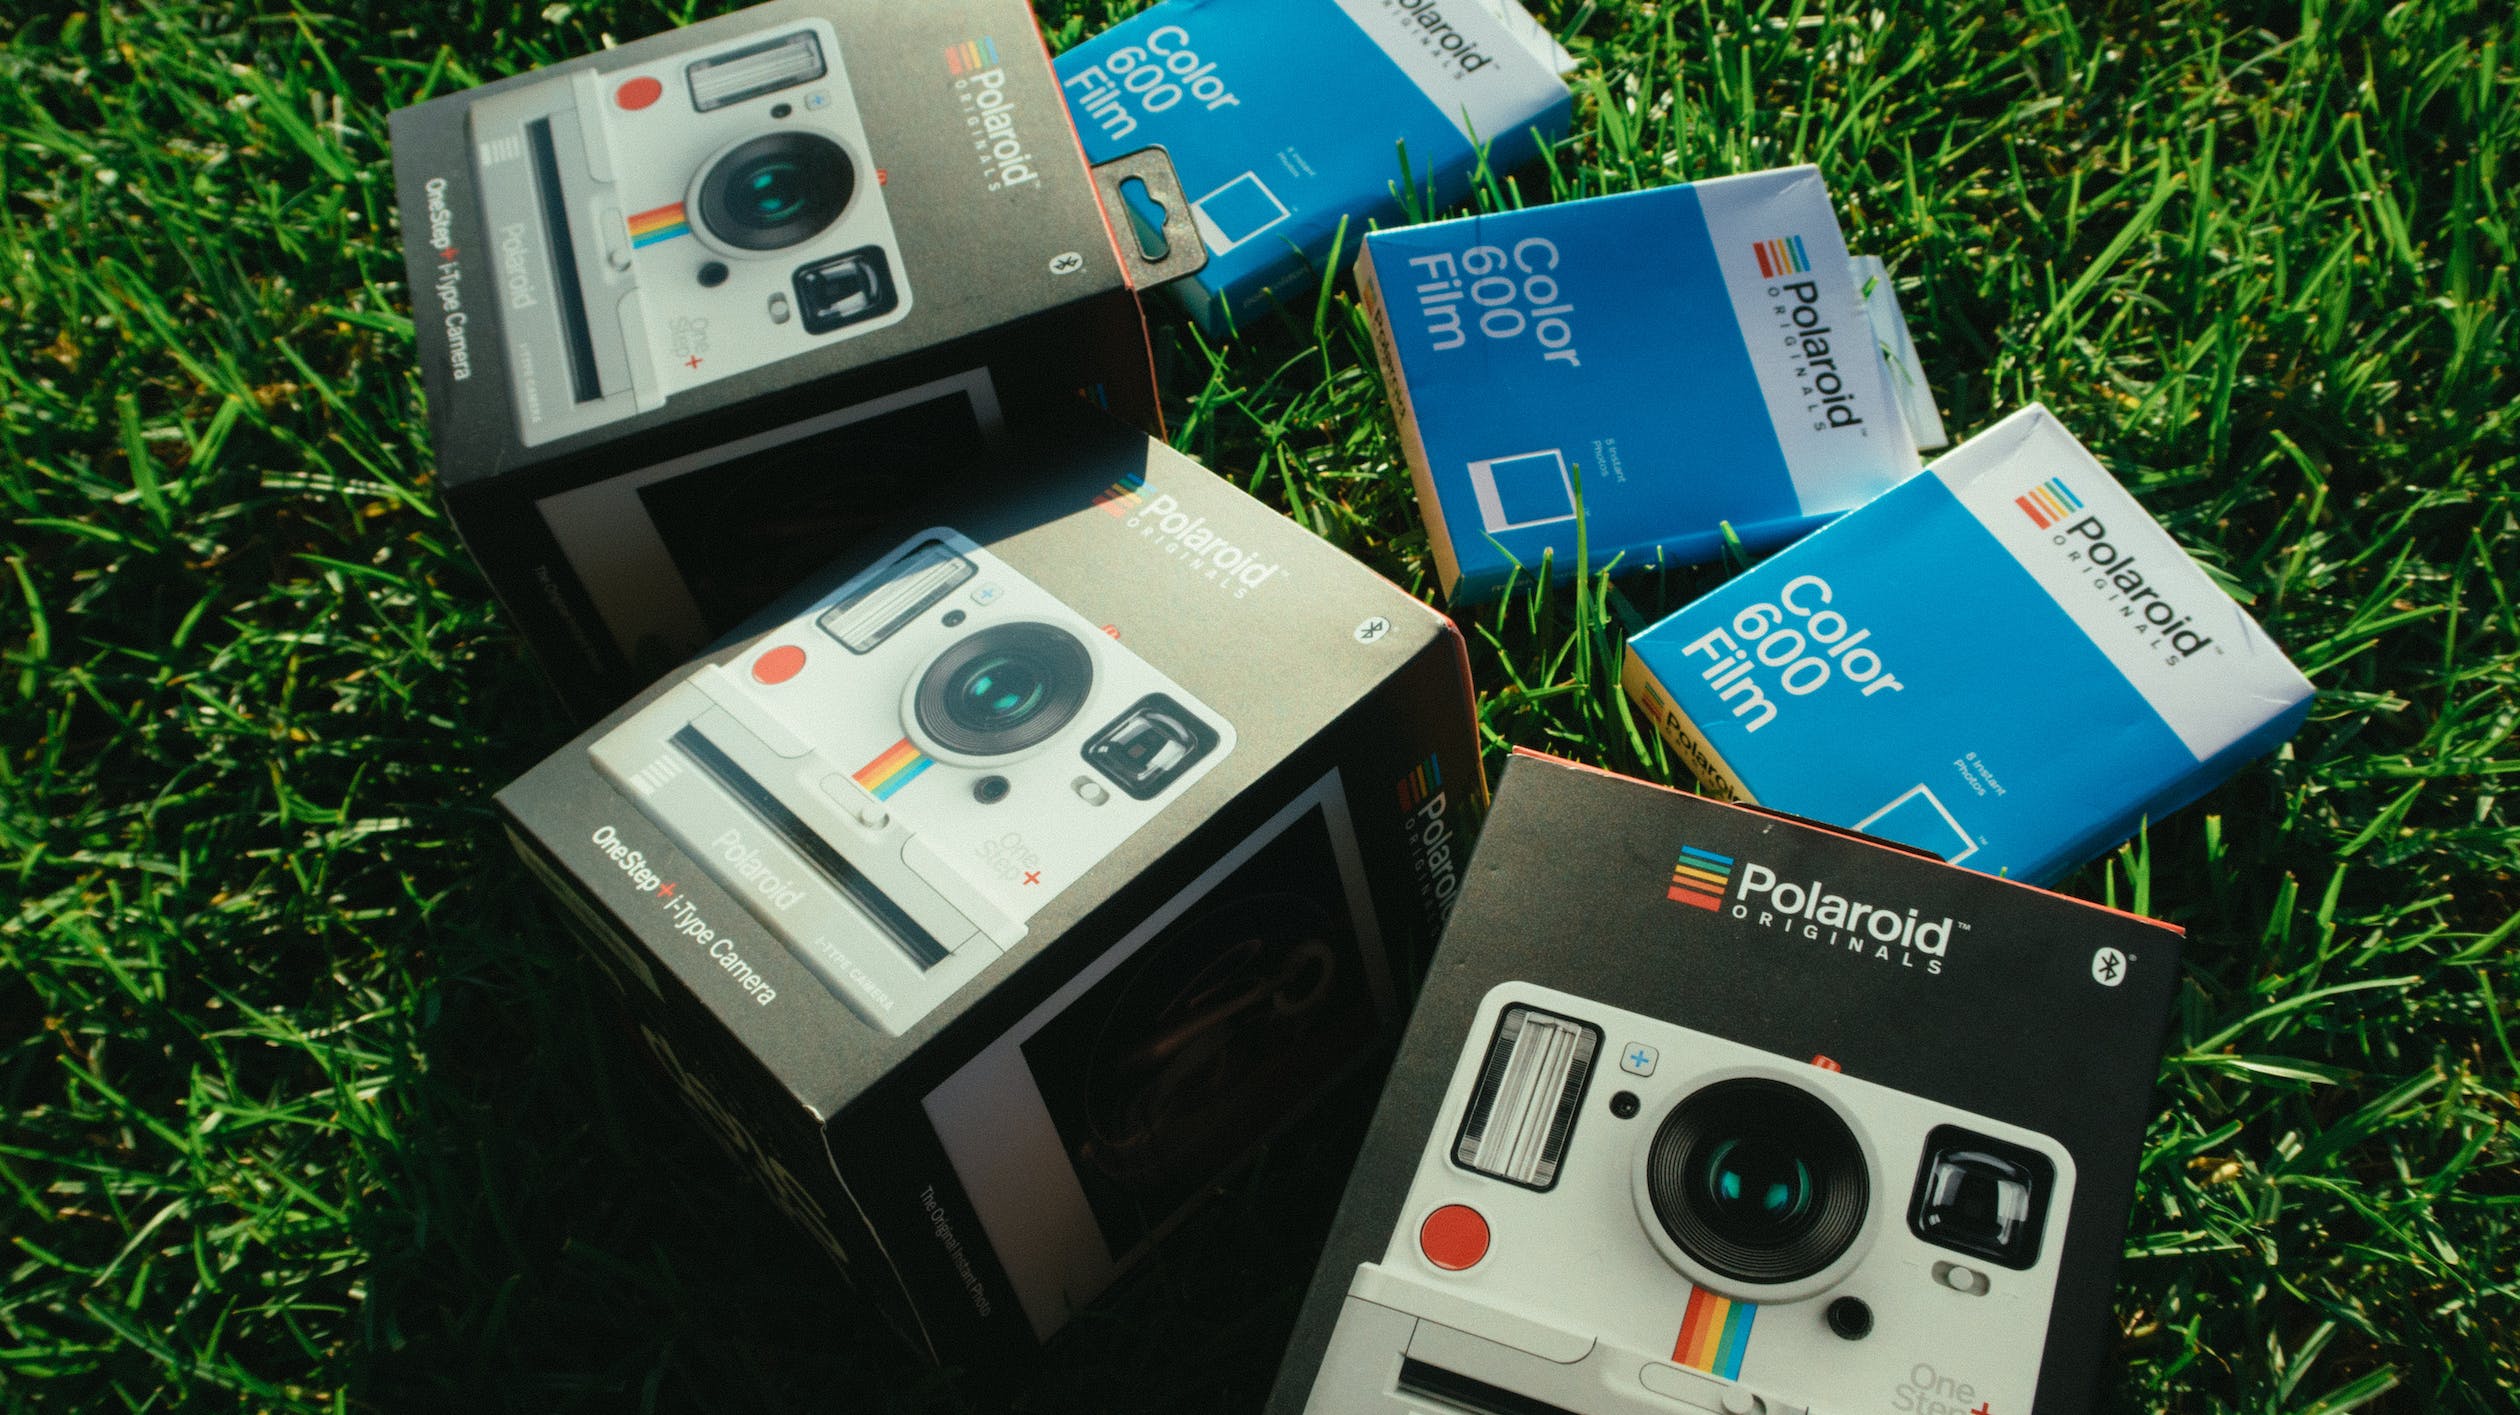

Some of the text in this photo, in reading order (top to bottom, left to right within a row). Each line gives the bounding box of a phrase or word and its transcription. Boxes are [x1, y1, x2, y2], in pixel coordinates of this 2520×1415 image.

[1063, 65, 1137, 141] Film
[1106, 46, 1183, 113] 600
[1147, 25, 1240, 111] Color
[955, 79, 1001, 192] ORIGINALS
[969, 68, 1038, 187] Polaroid
[502, 222, 537, 309] Polaroid
[1408, 252, 1466, 351] Film
[1462, 245, 1527, 339] 600
[1513, 237, 1581, 367] Color
[445, 312, 471, 381] Camera
[1768, 287, 1827, 432] ORIGINALS
[1783, 281, 1863, 428] Polaroid
[1127, 516, 1248, 600] ORIGINALS
[1138, 493, 1280, 589] Polaroid
[2065, 515, 2213, 658] Polaroid
[1781, 574, 1905, 697] Color
[2052, 534, 2180, 667] ORIGINALS
[1681, 626, 1778, 734] Film
[1733, 602, 1831, 696] 600
[1953, 758, 1986, 797] Photos
[1965, 751, 2007, 797] 8 Instant
[711, 828, 807, 911] Polaroid
[1736, 862, 1954, 958] Polaroid
[663, 894, 714, 945] i-Type
[709, 938, 777, 1007] Camera
[1732, 904, 1943, 975] ORIGINALS
[920, 1184, 937, 1212] The
[930, 1207, 961, 1251] Original
[1909, 1362, 1976, 1405] One
